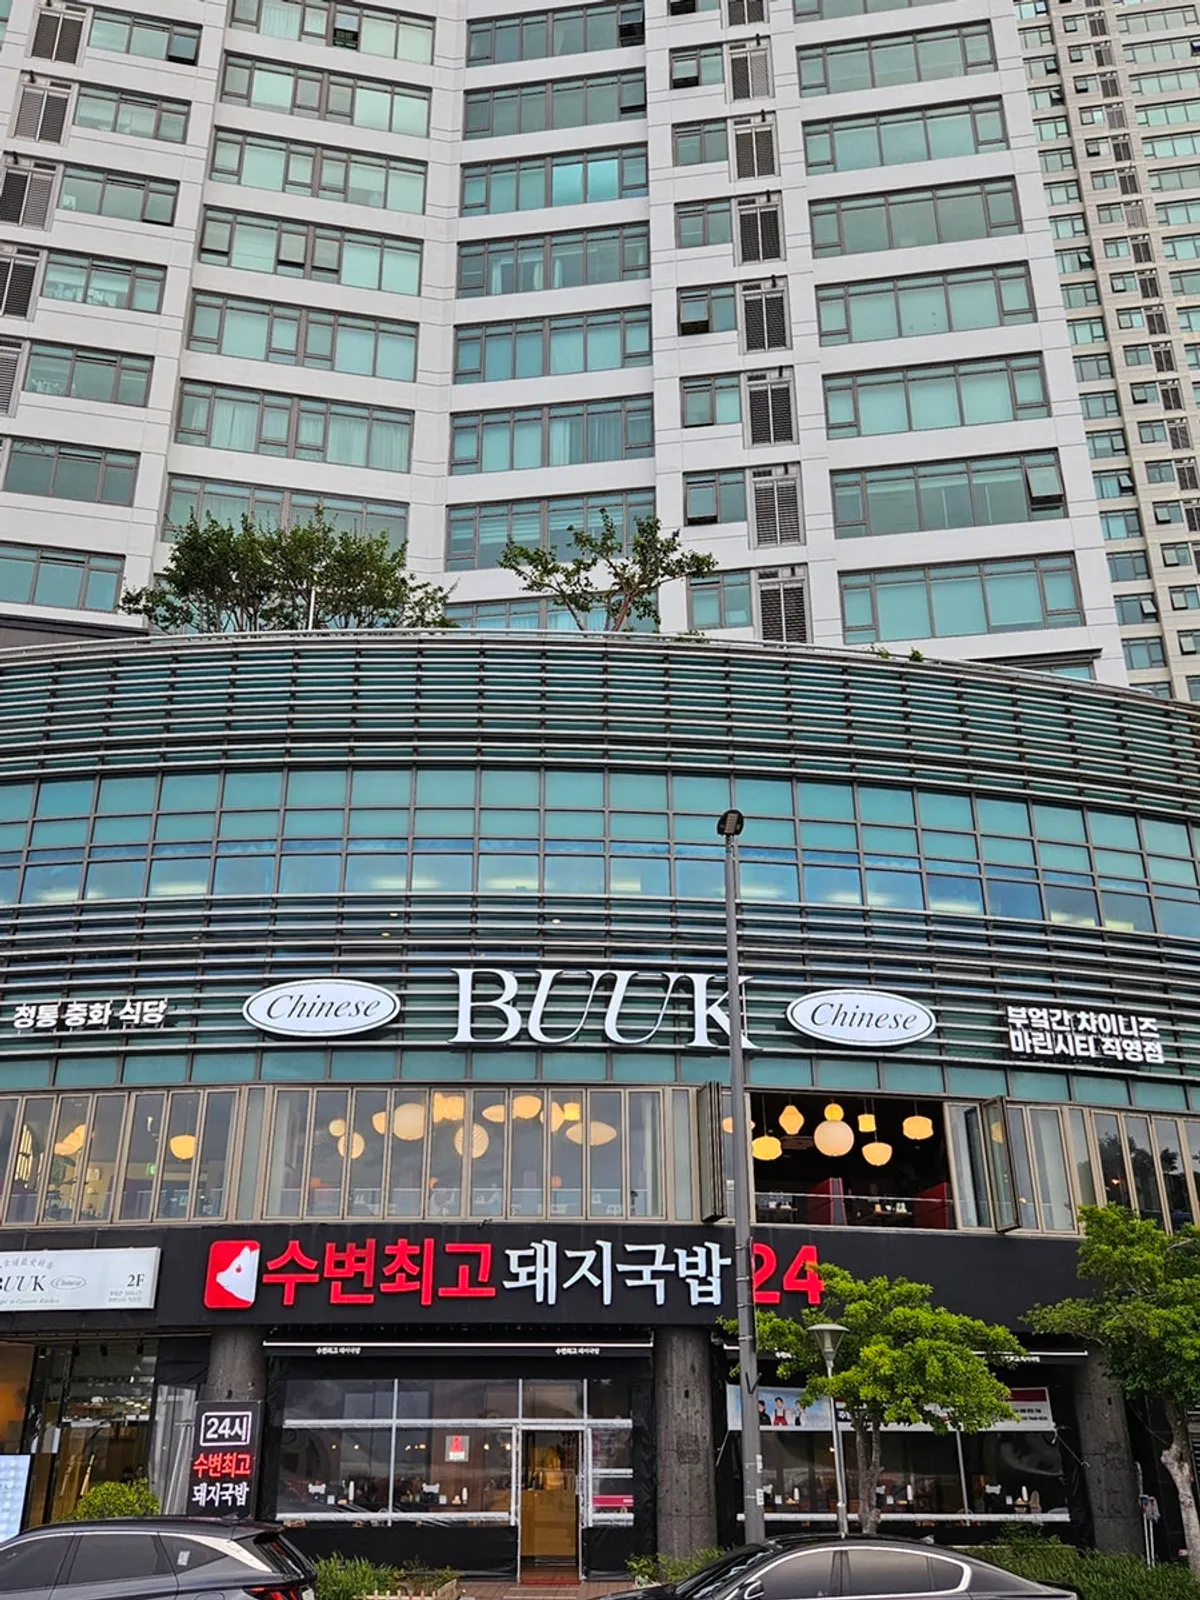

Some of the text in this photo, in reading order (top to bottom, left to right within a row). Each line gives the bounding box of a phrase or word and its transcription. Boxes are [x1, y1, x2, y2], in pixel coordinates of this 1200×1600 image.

[64, 1002, 112, 1027] 중화
[119, 1000, 167, 1024] 식당
[266, 994, 381, 1019] Chinese
[447, 968, 763, 1050] BUUK
[811, 1002, 917, 1030] Chinese
[1076, 1011, 1160, 1038] 차이니즈
[1009, 1029, 1164, 1064] 마린시티 직영점
[0, 1275, 46, 1292] UUK
[127, 1273, 145, 1287] 2F
[262, 1238, 825, 1306] 수변최고 돼지국밥 24
[206, 1417, 247, 1441] 24시
[193, 1452, 251, 1478] 수변최고
[192, 1481, 250, 1507] 돼지국밥
